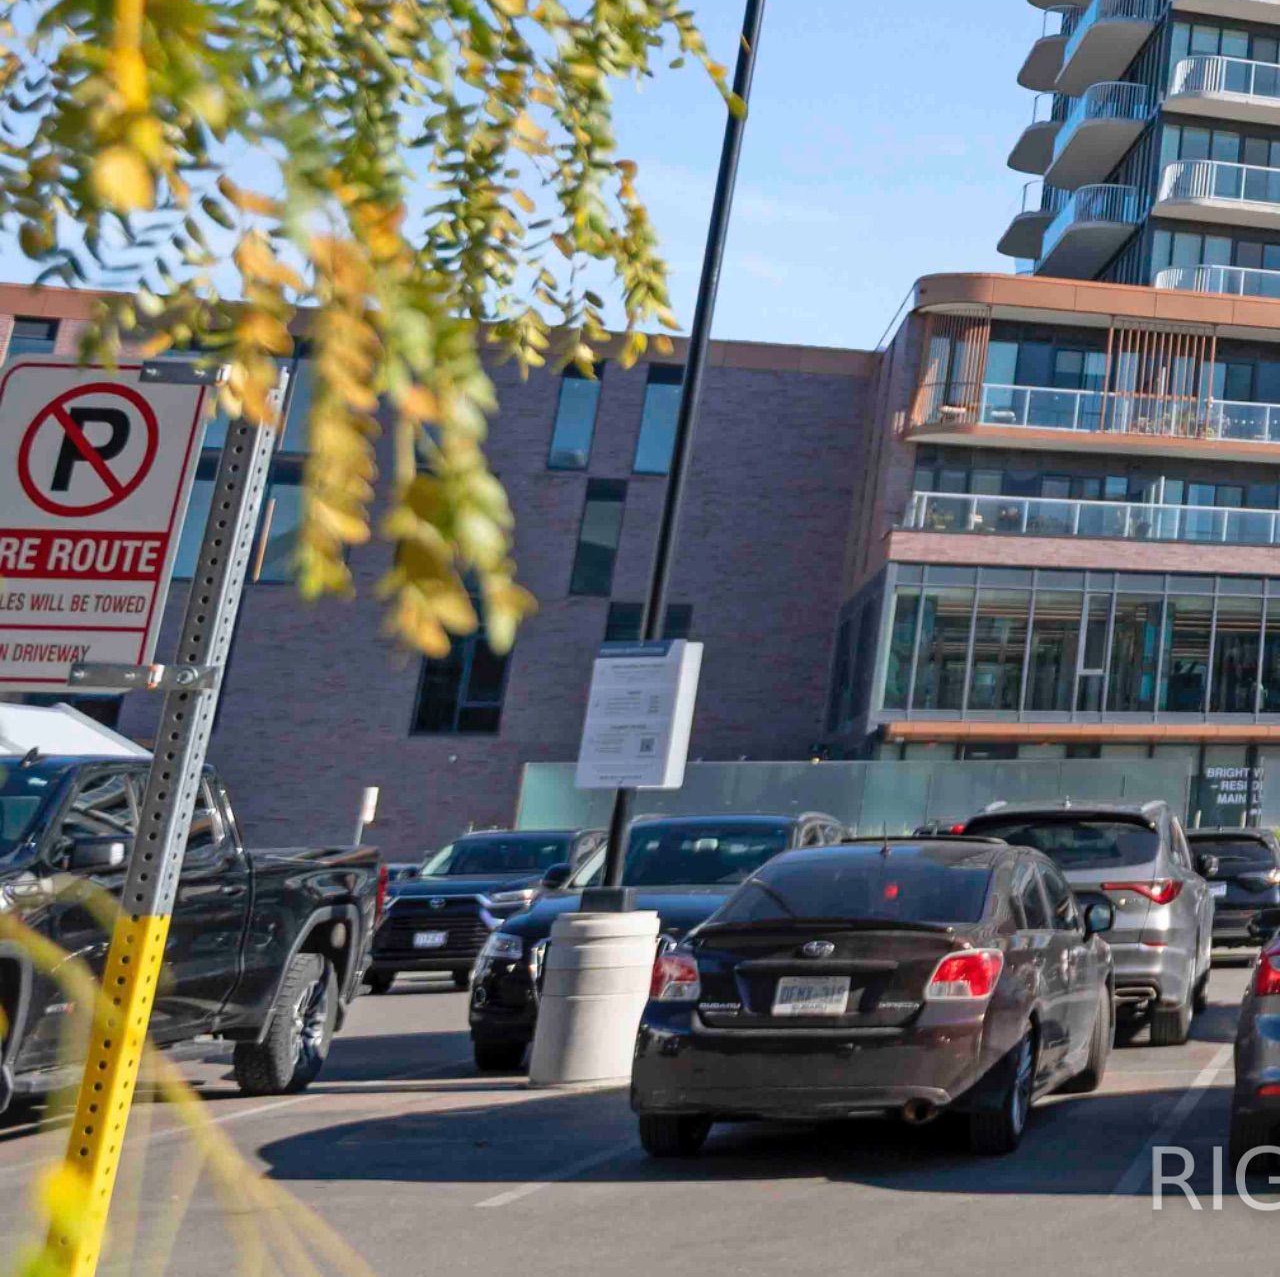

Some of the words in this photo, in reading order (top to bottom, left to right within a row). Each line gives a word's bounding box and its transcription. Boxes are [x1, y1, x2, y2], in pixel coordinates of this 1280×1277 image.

[47, 538, 161, 572] ROUTE
[30, 593, 65, 612] WILL
[69, 594, 89, 612] BE
[94, 594, 146, 614] TOWED
[12, 643, 91, 663] DRIVEWAY
